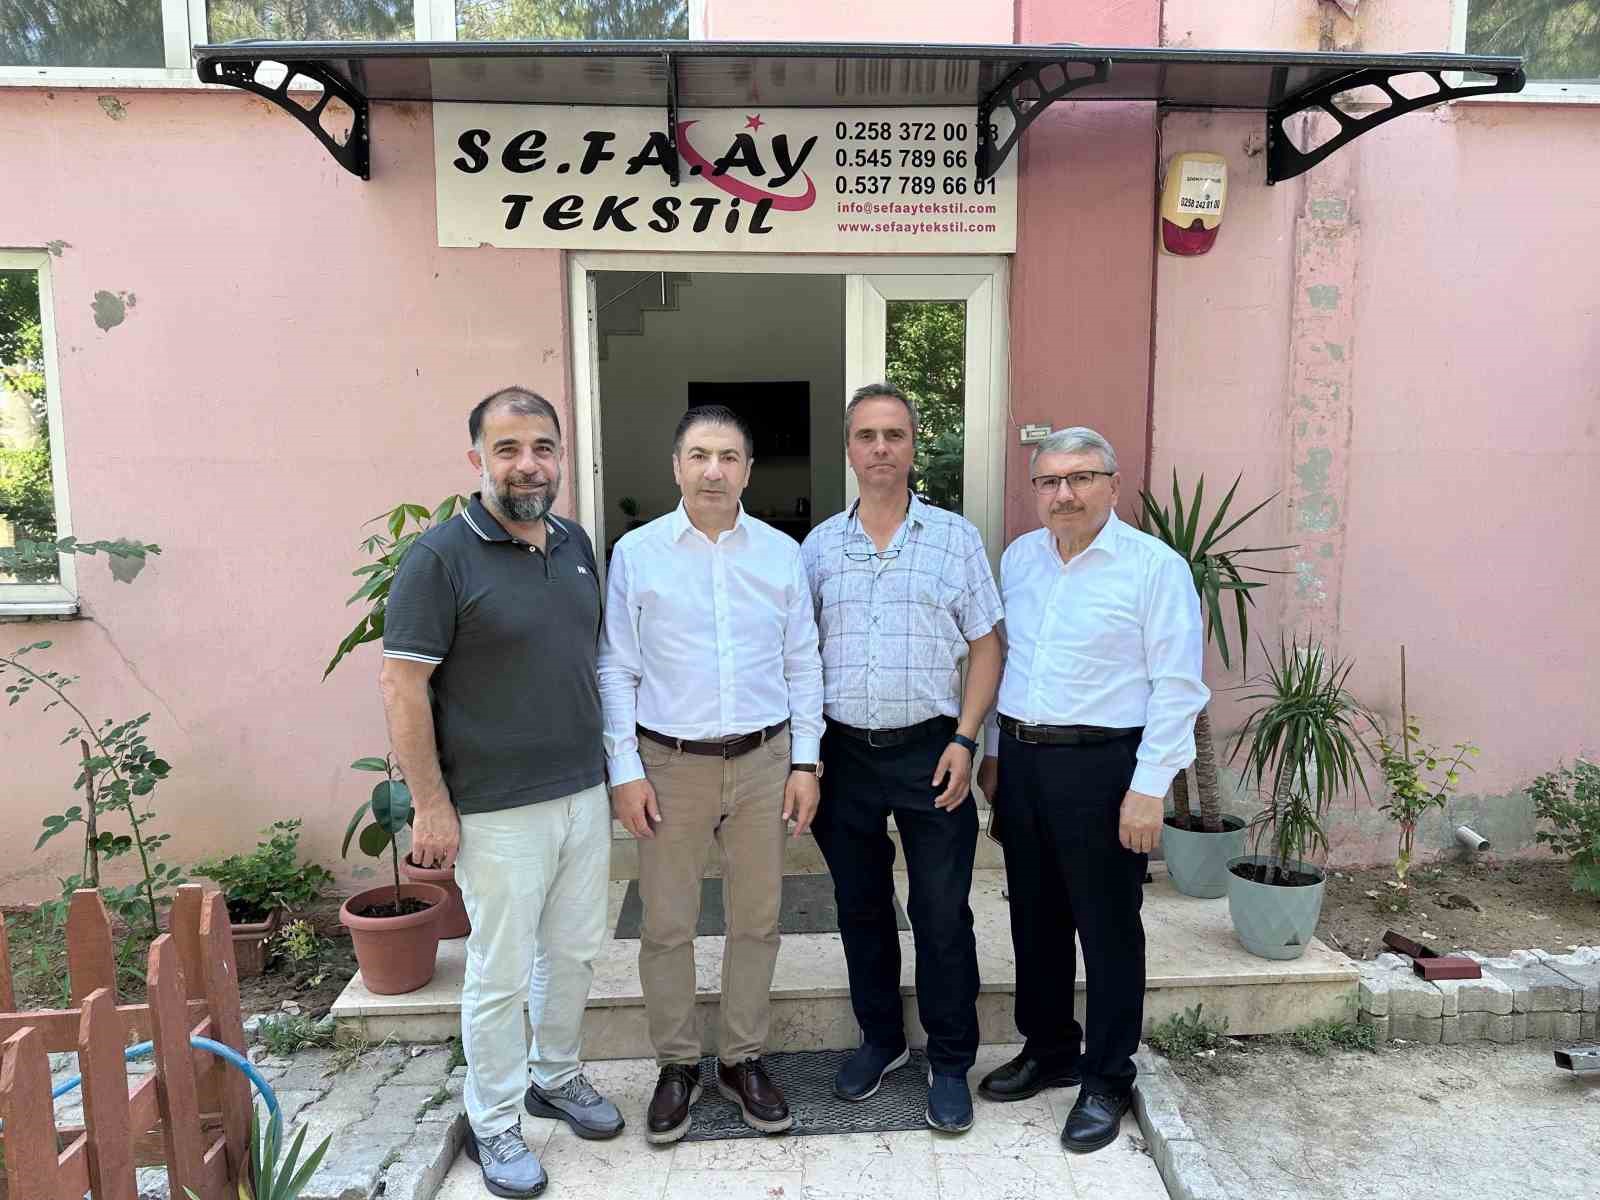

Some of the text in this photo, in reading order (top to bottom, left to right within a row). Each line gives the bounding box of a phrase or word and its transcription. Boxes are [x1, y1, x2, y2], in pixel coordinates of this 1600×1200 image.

[835, 121, 892, 141] 0.258
[899, 122, 936, 141] 372
[943, 123, 968, 141] 00
[835, 148, 892, 168] 0.545
[899, 149, 936, 168] 789
[943, 150, 967, 168] 66
[835, 176, 997, 195] 0.537 789 66 01
[837, 202, 996, 216] info@sefaaytekstil.com
[837, 221, 996, 235] www.sefaaytekstil.com
